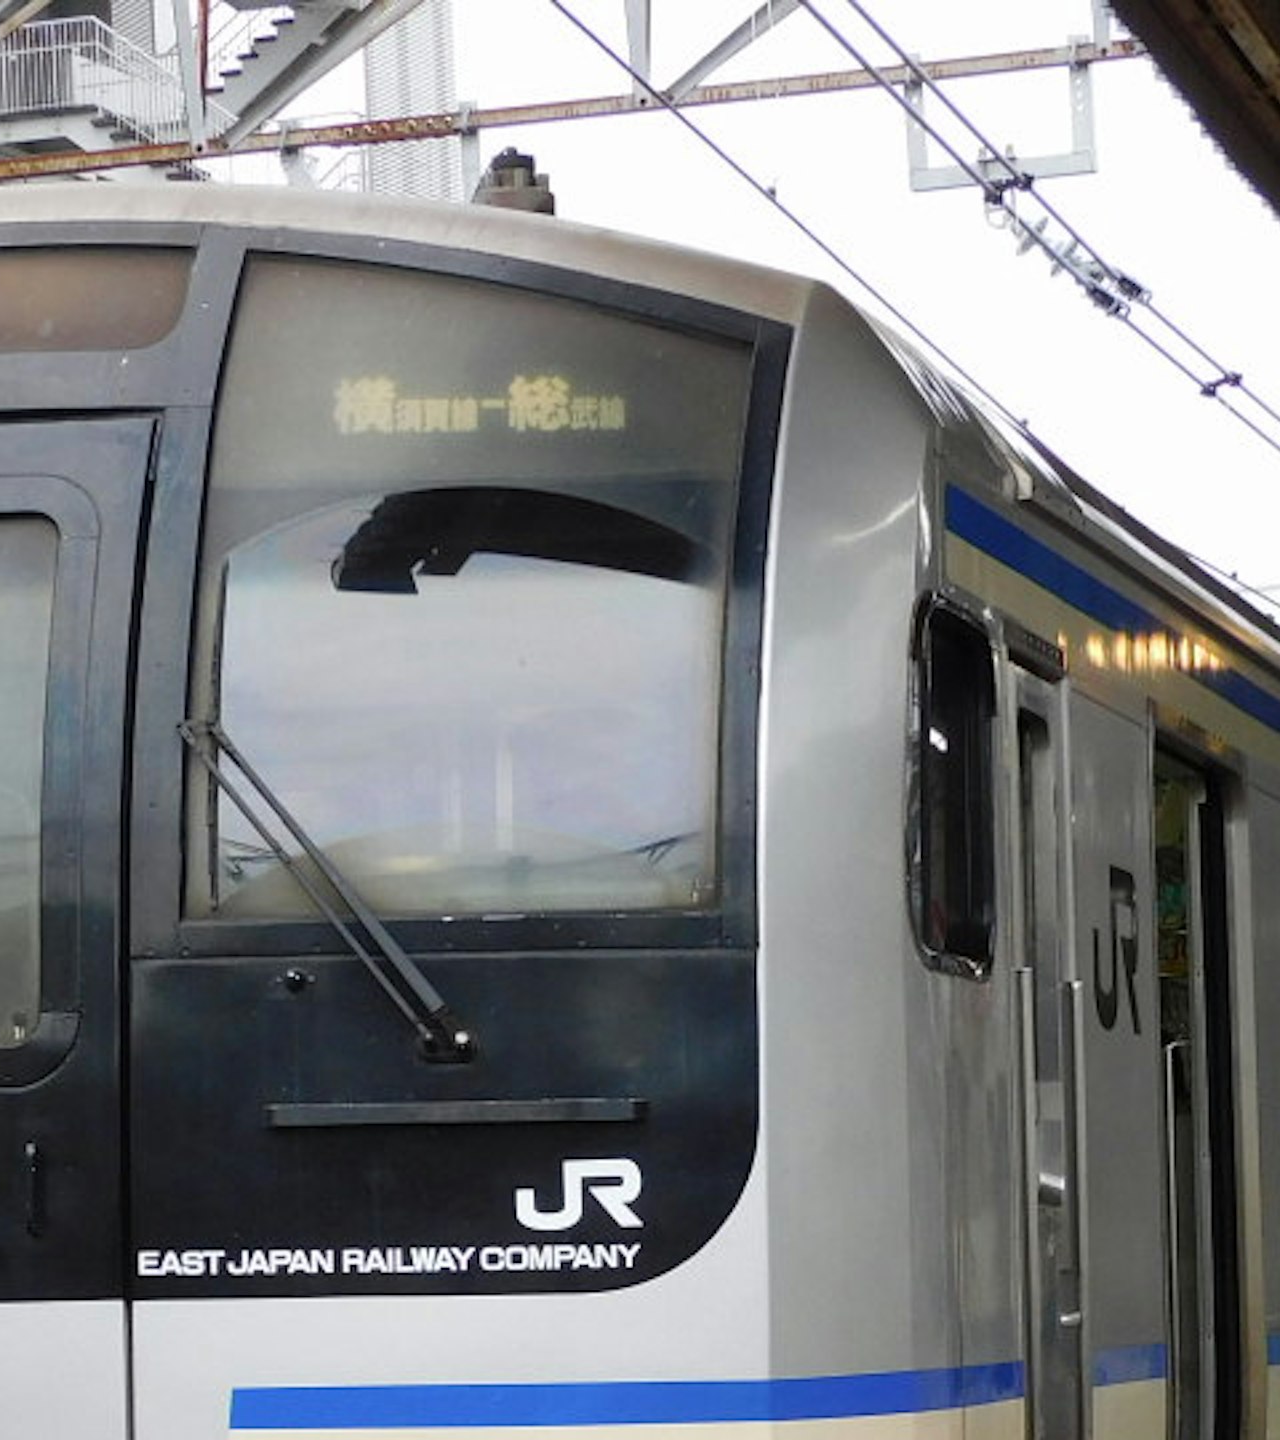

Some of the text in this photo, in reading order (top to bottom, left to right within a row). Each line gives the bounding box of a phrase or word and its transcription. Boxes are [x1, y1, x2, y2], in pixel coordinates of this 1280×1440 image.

[1093, 865, 1142, 1036] JR
[516, 1158, 644, 1231] JR
[136, 1244, 641, 1276] EAST JAPAN RAILWAY COMPANY
